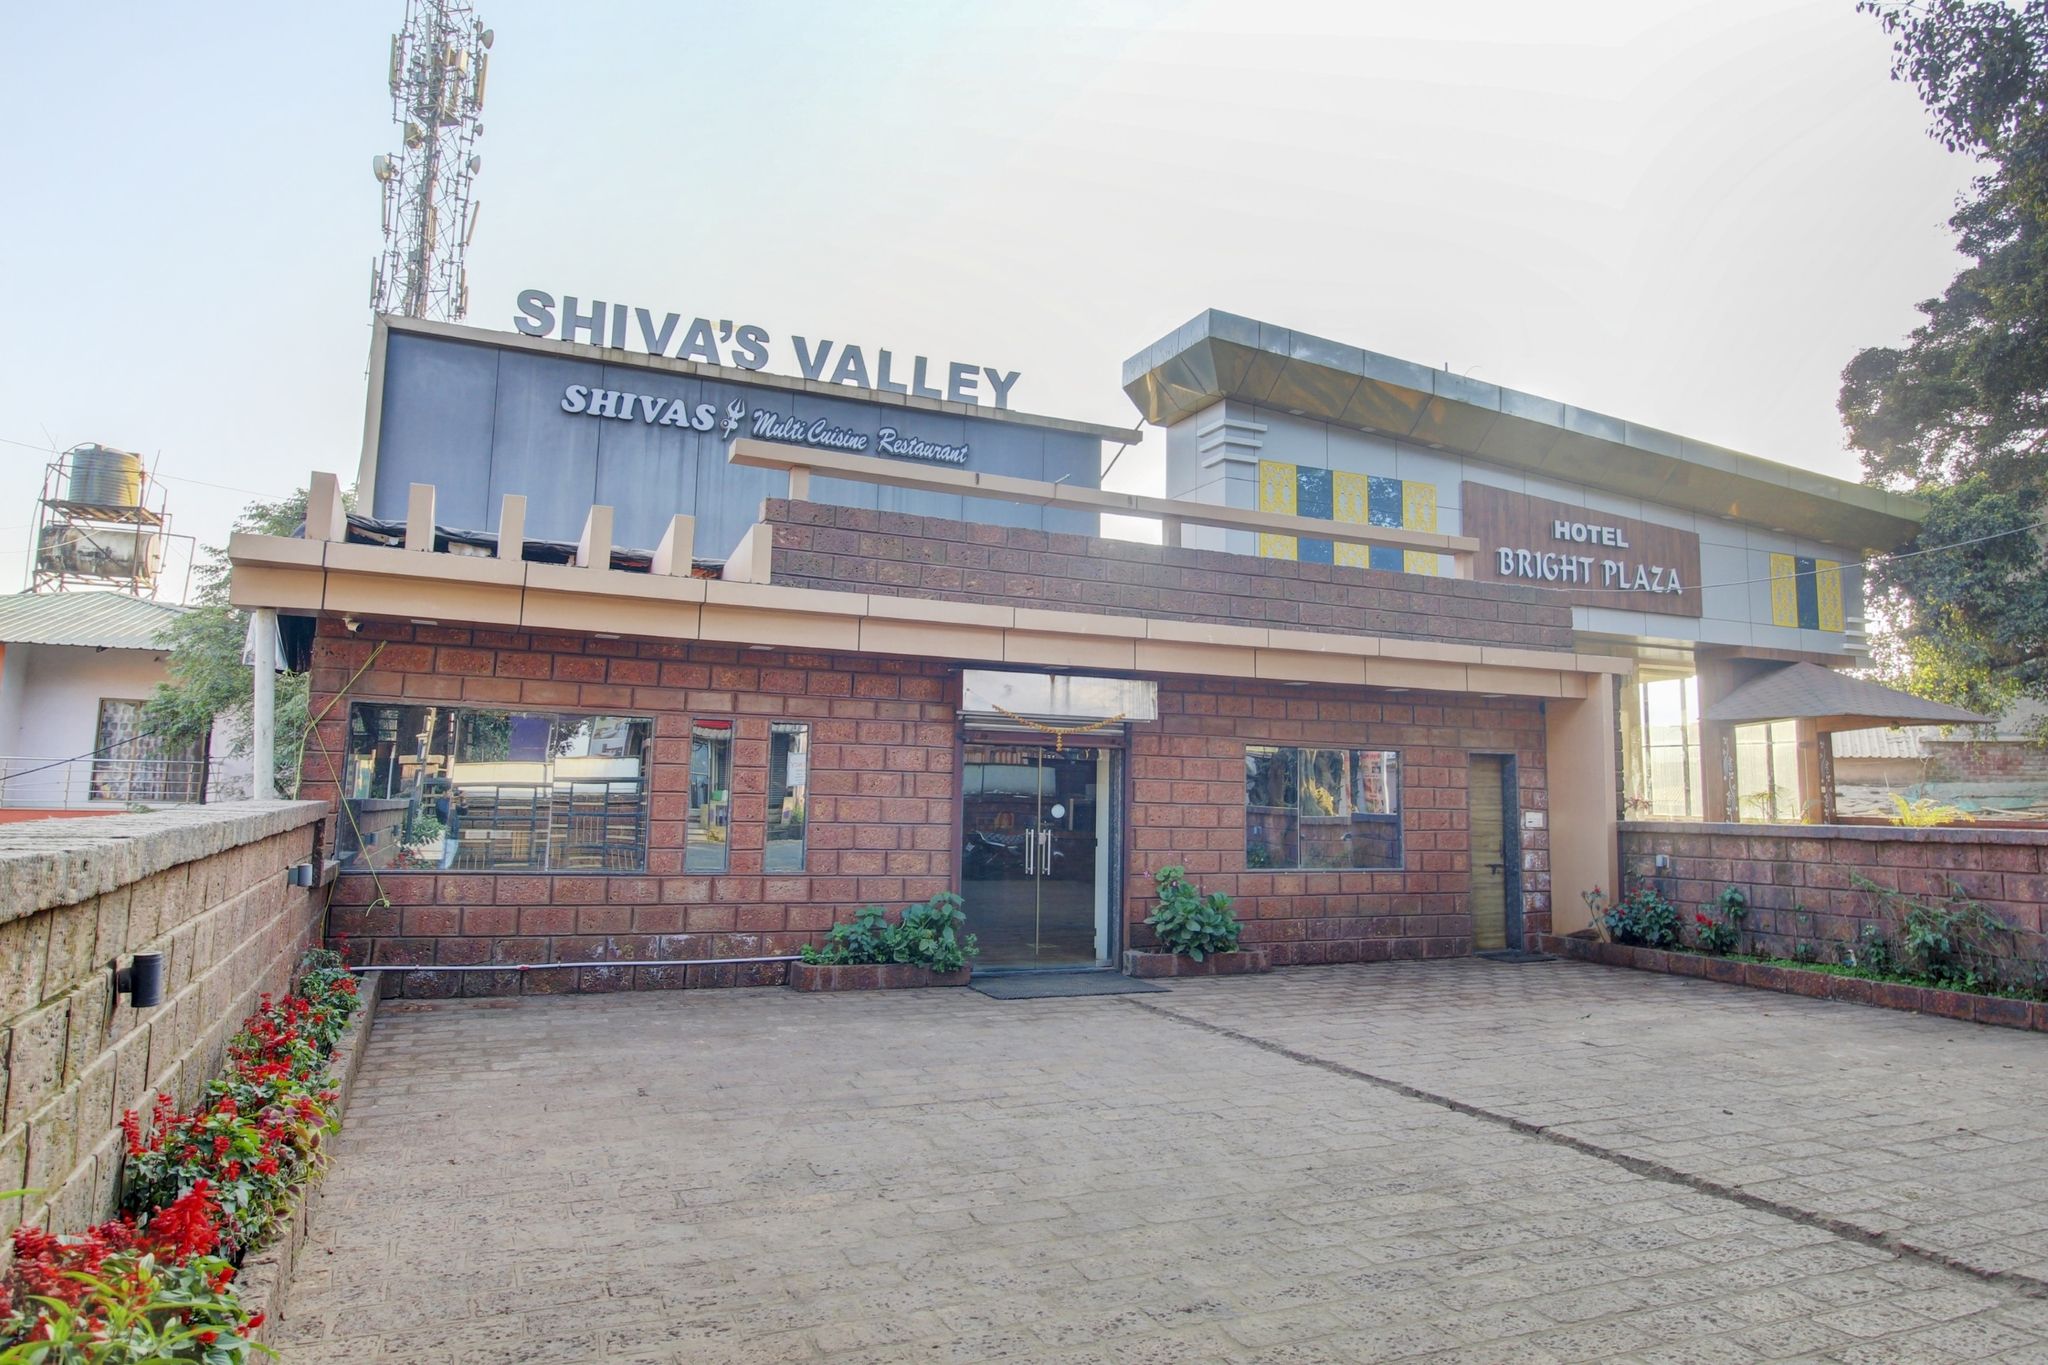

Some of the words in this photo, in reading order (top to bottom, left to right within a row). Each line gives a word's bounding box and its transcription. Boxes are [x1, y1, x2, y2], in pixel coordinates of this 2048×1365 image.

[514, 289, 769, 371] SHIVA'S
[792, 335, 1021, 409] VALLEY
[561, 384, 717, 431] SHIVAS
[752, 408, 806, 440] Multi
[807, 419, 868, 450] Cuisine
[877, 427, 969, 463] Restaurant
[1554, 520, 1629, 548] HOTEL
[1496, 547, 1595, 585] BRIGHT
[1600, 559, 1683, 595] PLAZA
